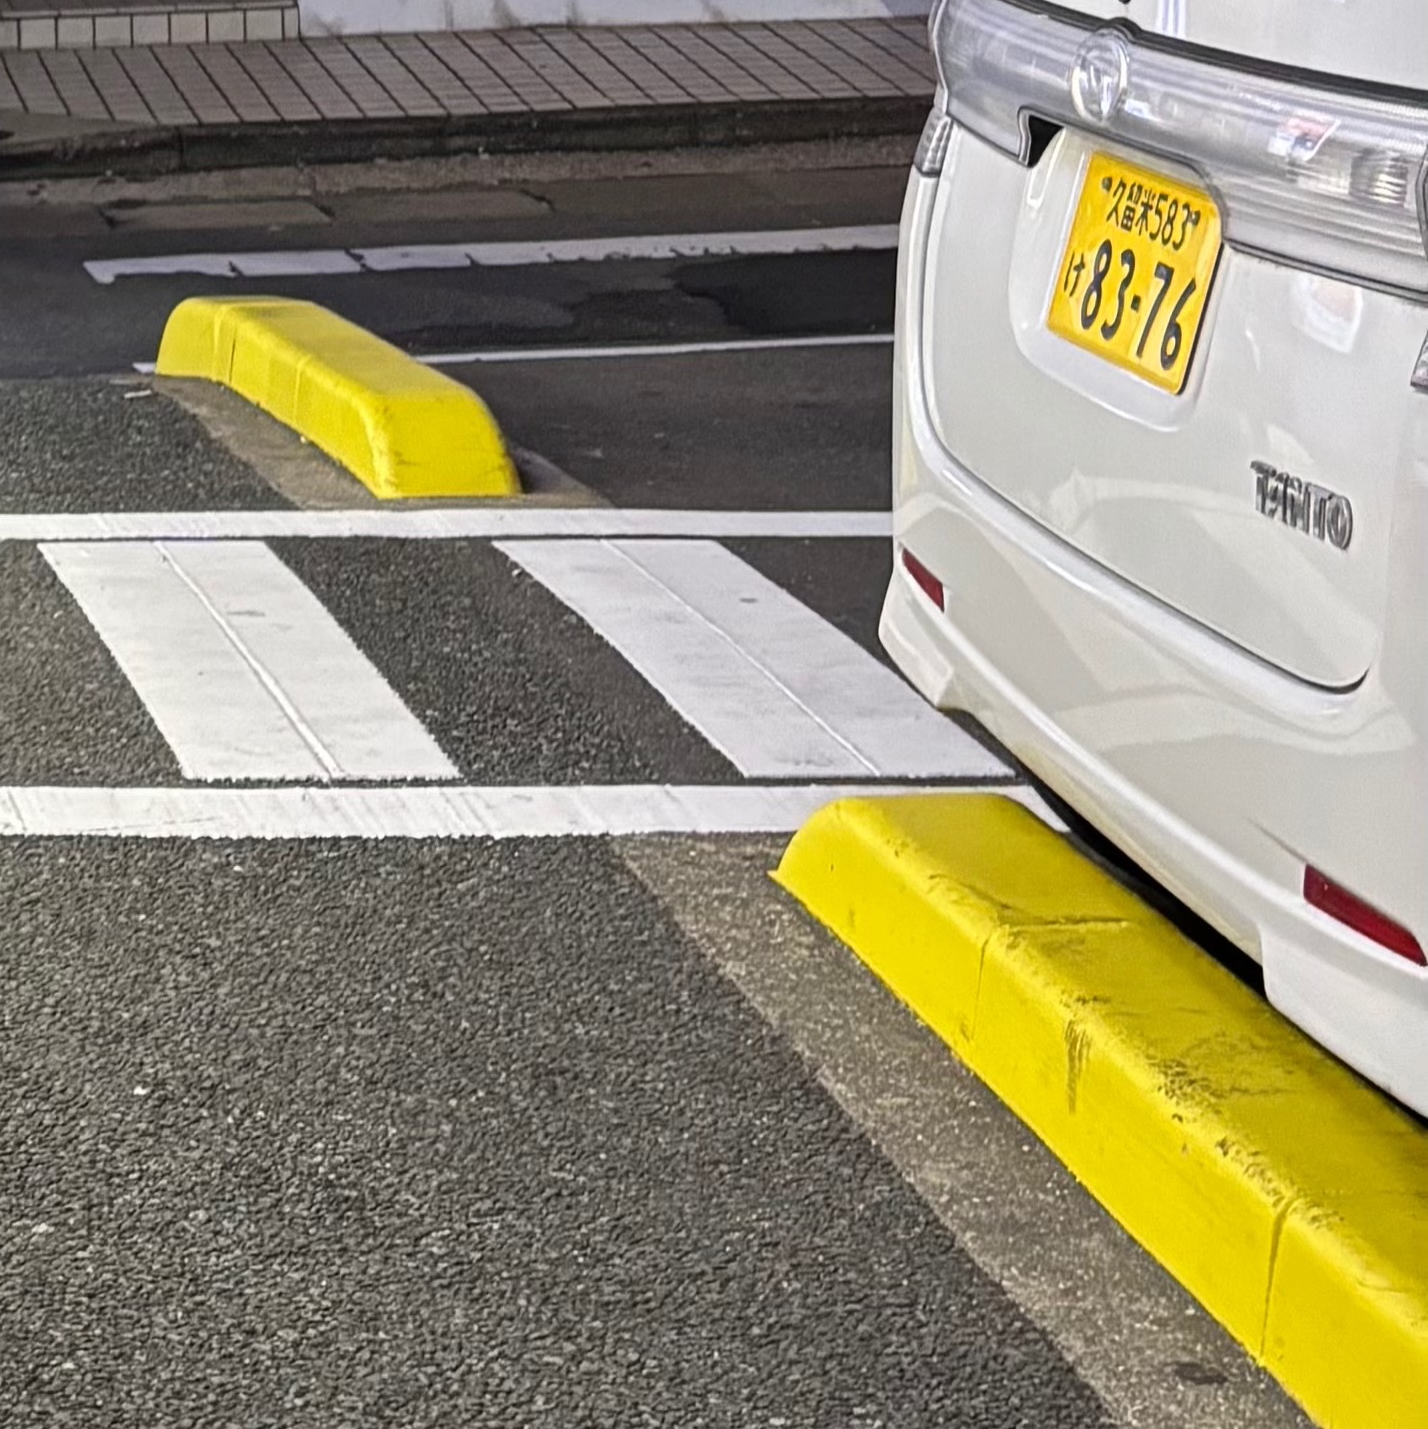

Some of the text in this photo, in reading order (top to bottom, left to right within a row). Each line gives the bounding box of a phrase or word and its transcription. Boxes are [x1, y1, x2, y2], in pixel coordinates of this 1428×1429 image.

[1105, 177, 1191, 252] 久留米 583
[1063, 238, 1197, 371] け 83-76
